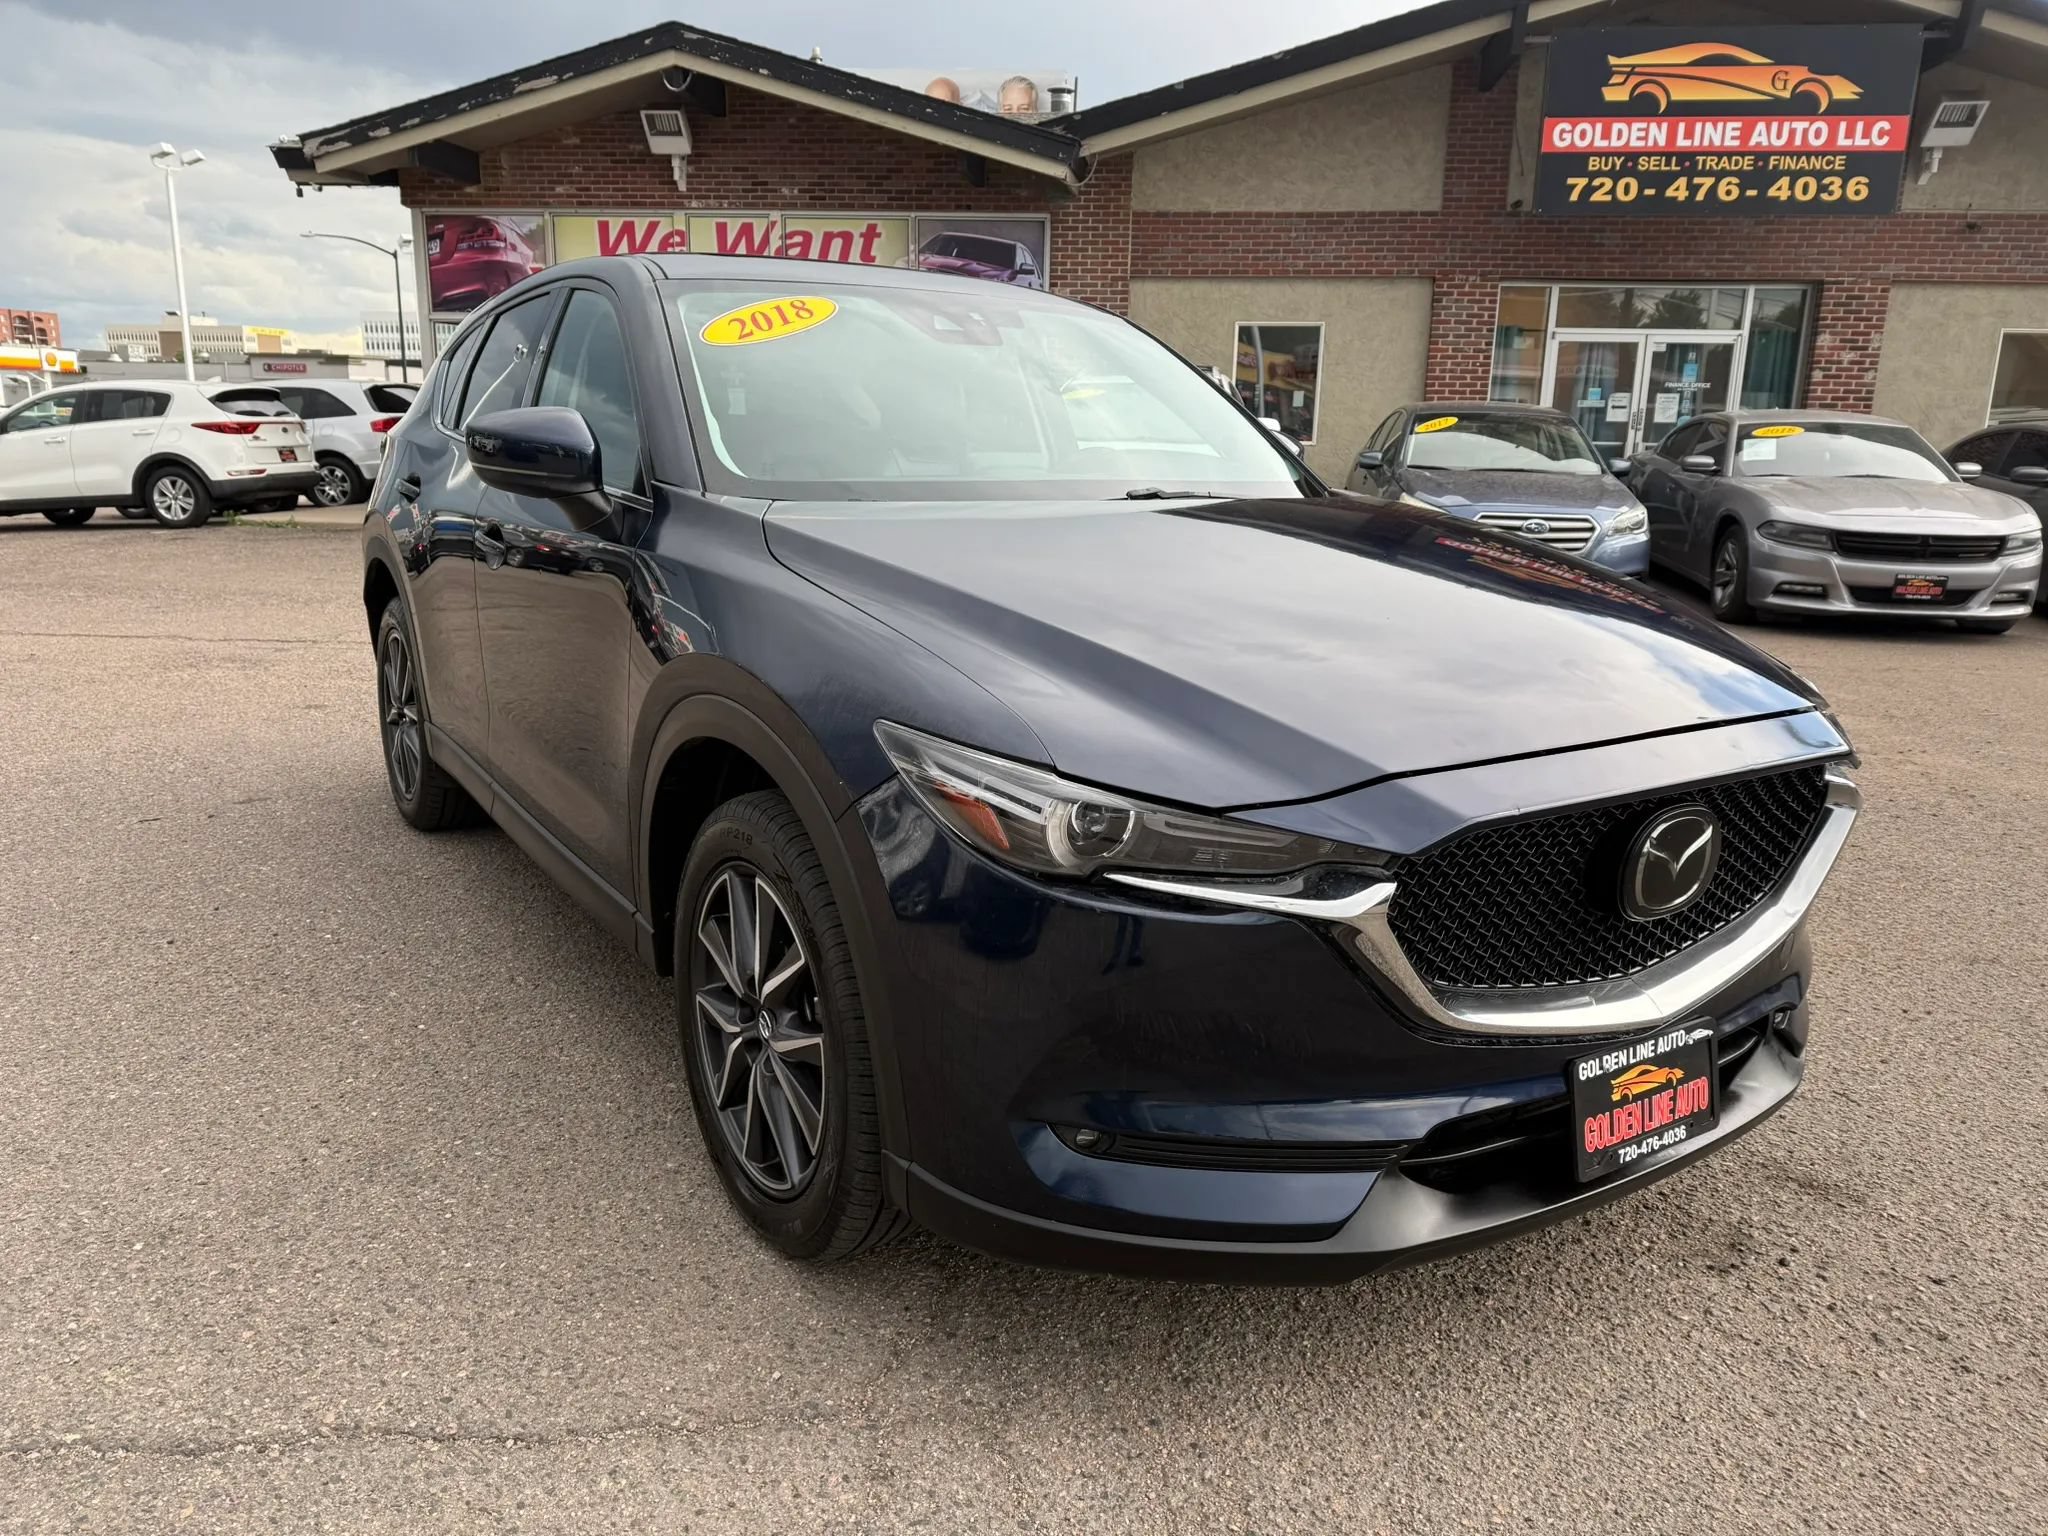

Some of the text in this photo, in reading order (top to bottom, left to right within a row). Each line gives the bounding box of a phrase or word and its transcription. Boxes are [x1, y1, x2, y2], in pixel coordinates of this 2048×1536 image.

[1770, 69, 1790, 91] G
[1552, 121, 1892, 148] GOLDEN LINE AUTO LLC
[1588, 155, 1847, 171] BUY SELL TRADE FINANCE
[597, 220, 882, 263] We Want
[727, 299, 815, 340] 2018
[1424, 418, 1449, 430] 2017
[1578, 1029, 1686, 1081] GOLDEN LINE AUTO
[1584, 1076, 1709, 1153] GOLDEN LINE AUTO
[1618, 1125, 1687, 1164] 720-476-4036
